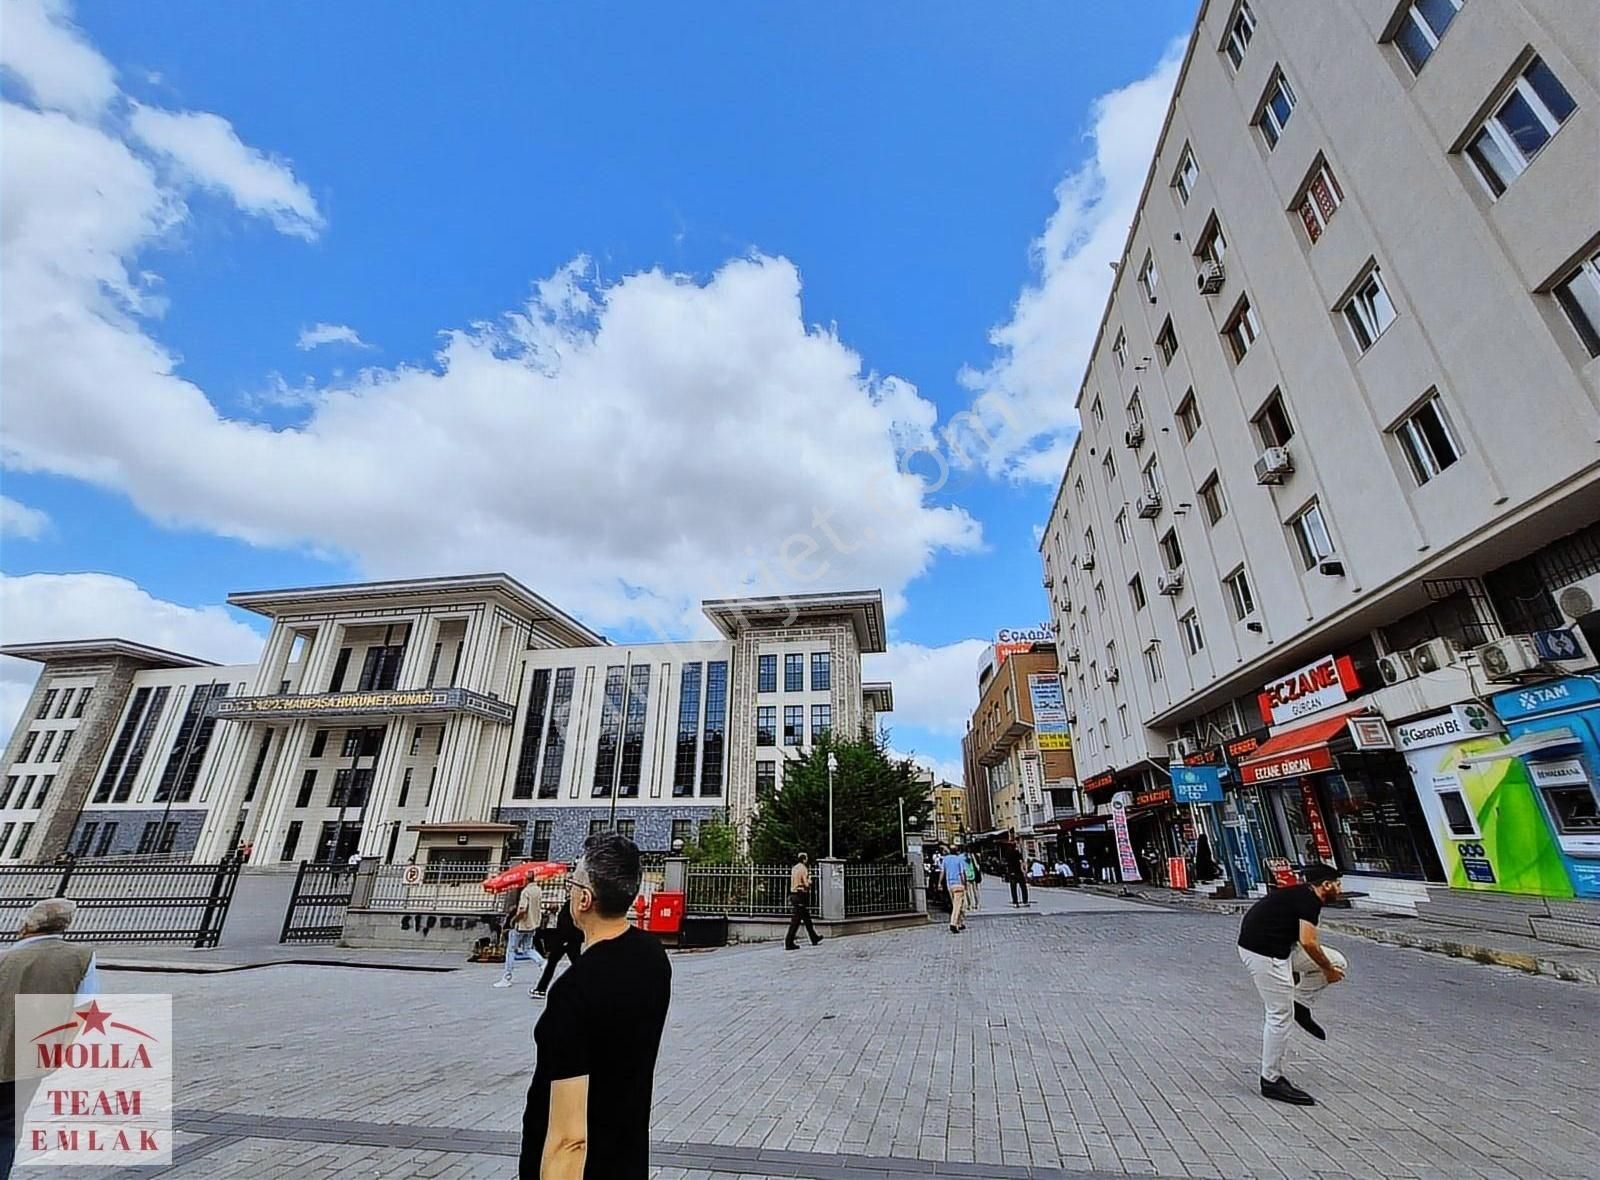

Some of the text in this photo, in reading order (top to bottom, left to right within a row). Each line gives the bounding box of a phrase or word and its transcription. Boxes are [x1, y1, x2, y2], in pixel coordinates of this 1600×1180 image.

[1266, 660, 1339, 709] ECZANE
[1533, 684, 1569, 702] TAM
[1409, 723, 1446, 741] Garanti
